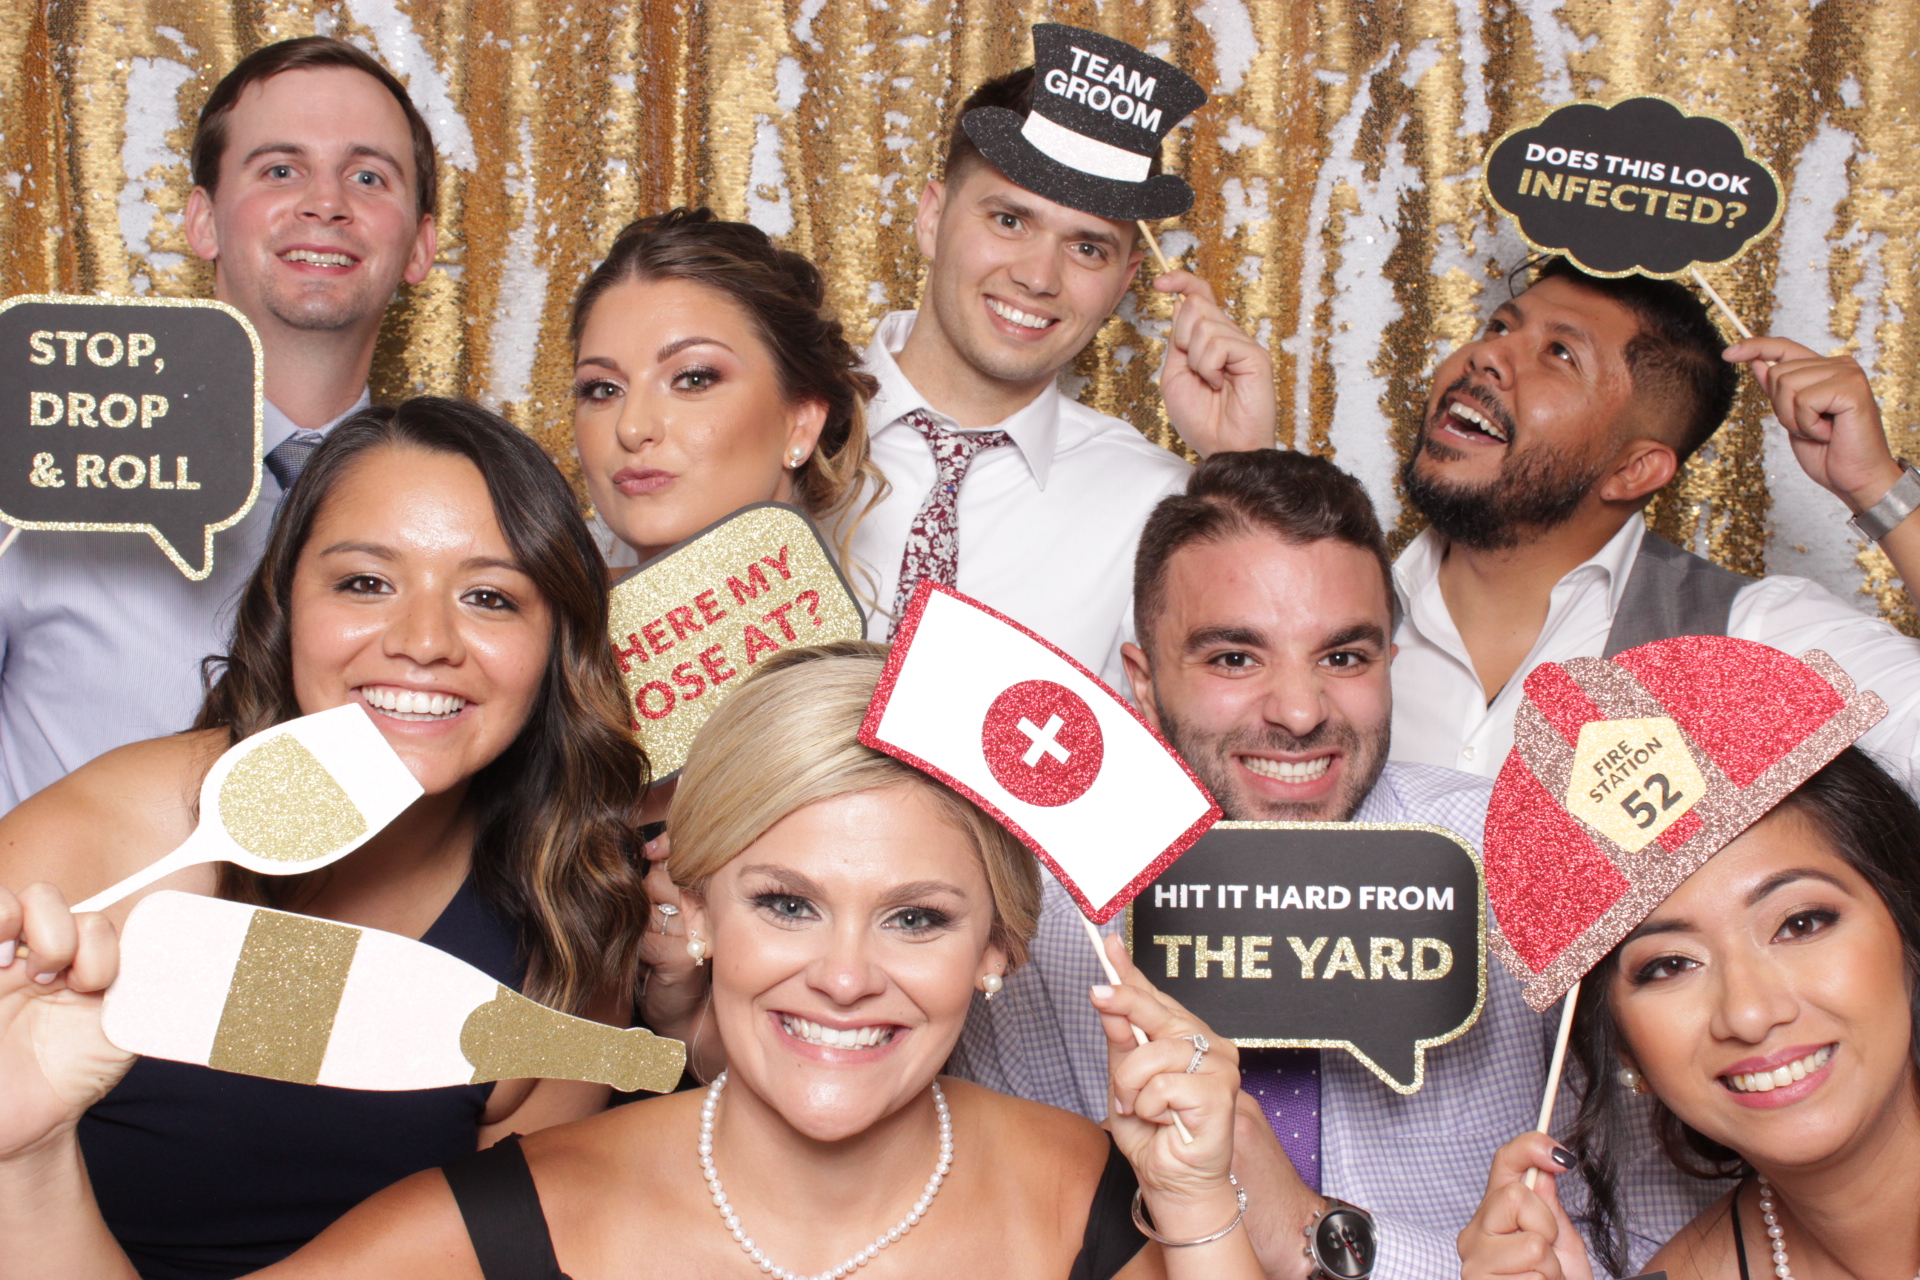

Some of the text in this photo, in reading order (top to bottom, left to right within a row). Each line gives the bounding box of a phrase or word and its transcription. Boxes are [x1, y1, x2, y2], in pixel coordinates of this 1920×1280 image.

[1044, 69, 1163, 133] GROOM
[1070, 46, 1157, 102] TEAM
[1525, 143, 1750, 195] DOES THIS LOOK
[1517, 168, 1748, 229] INFECTED?
[29, 330, 165, 375] STOP,
[30, 392, 169, 429] DROP
[29, 452, 201, 490] & ROLL
[611, 545, 792, 674] HERE MY
[631, 590, 822, 732] OSE AT?
[1589, 737, 1663, 803] STATION
[1592, 740, 1633, 777] FIRE
[1620, 773, 1684, 829] 52
[1154, 884, 1455, 910] HIT IT HARD FROM
[1153, 935, 1454, 981] THE YARD
